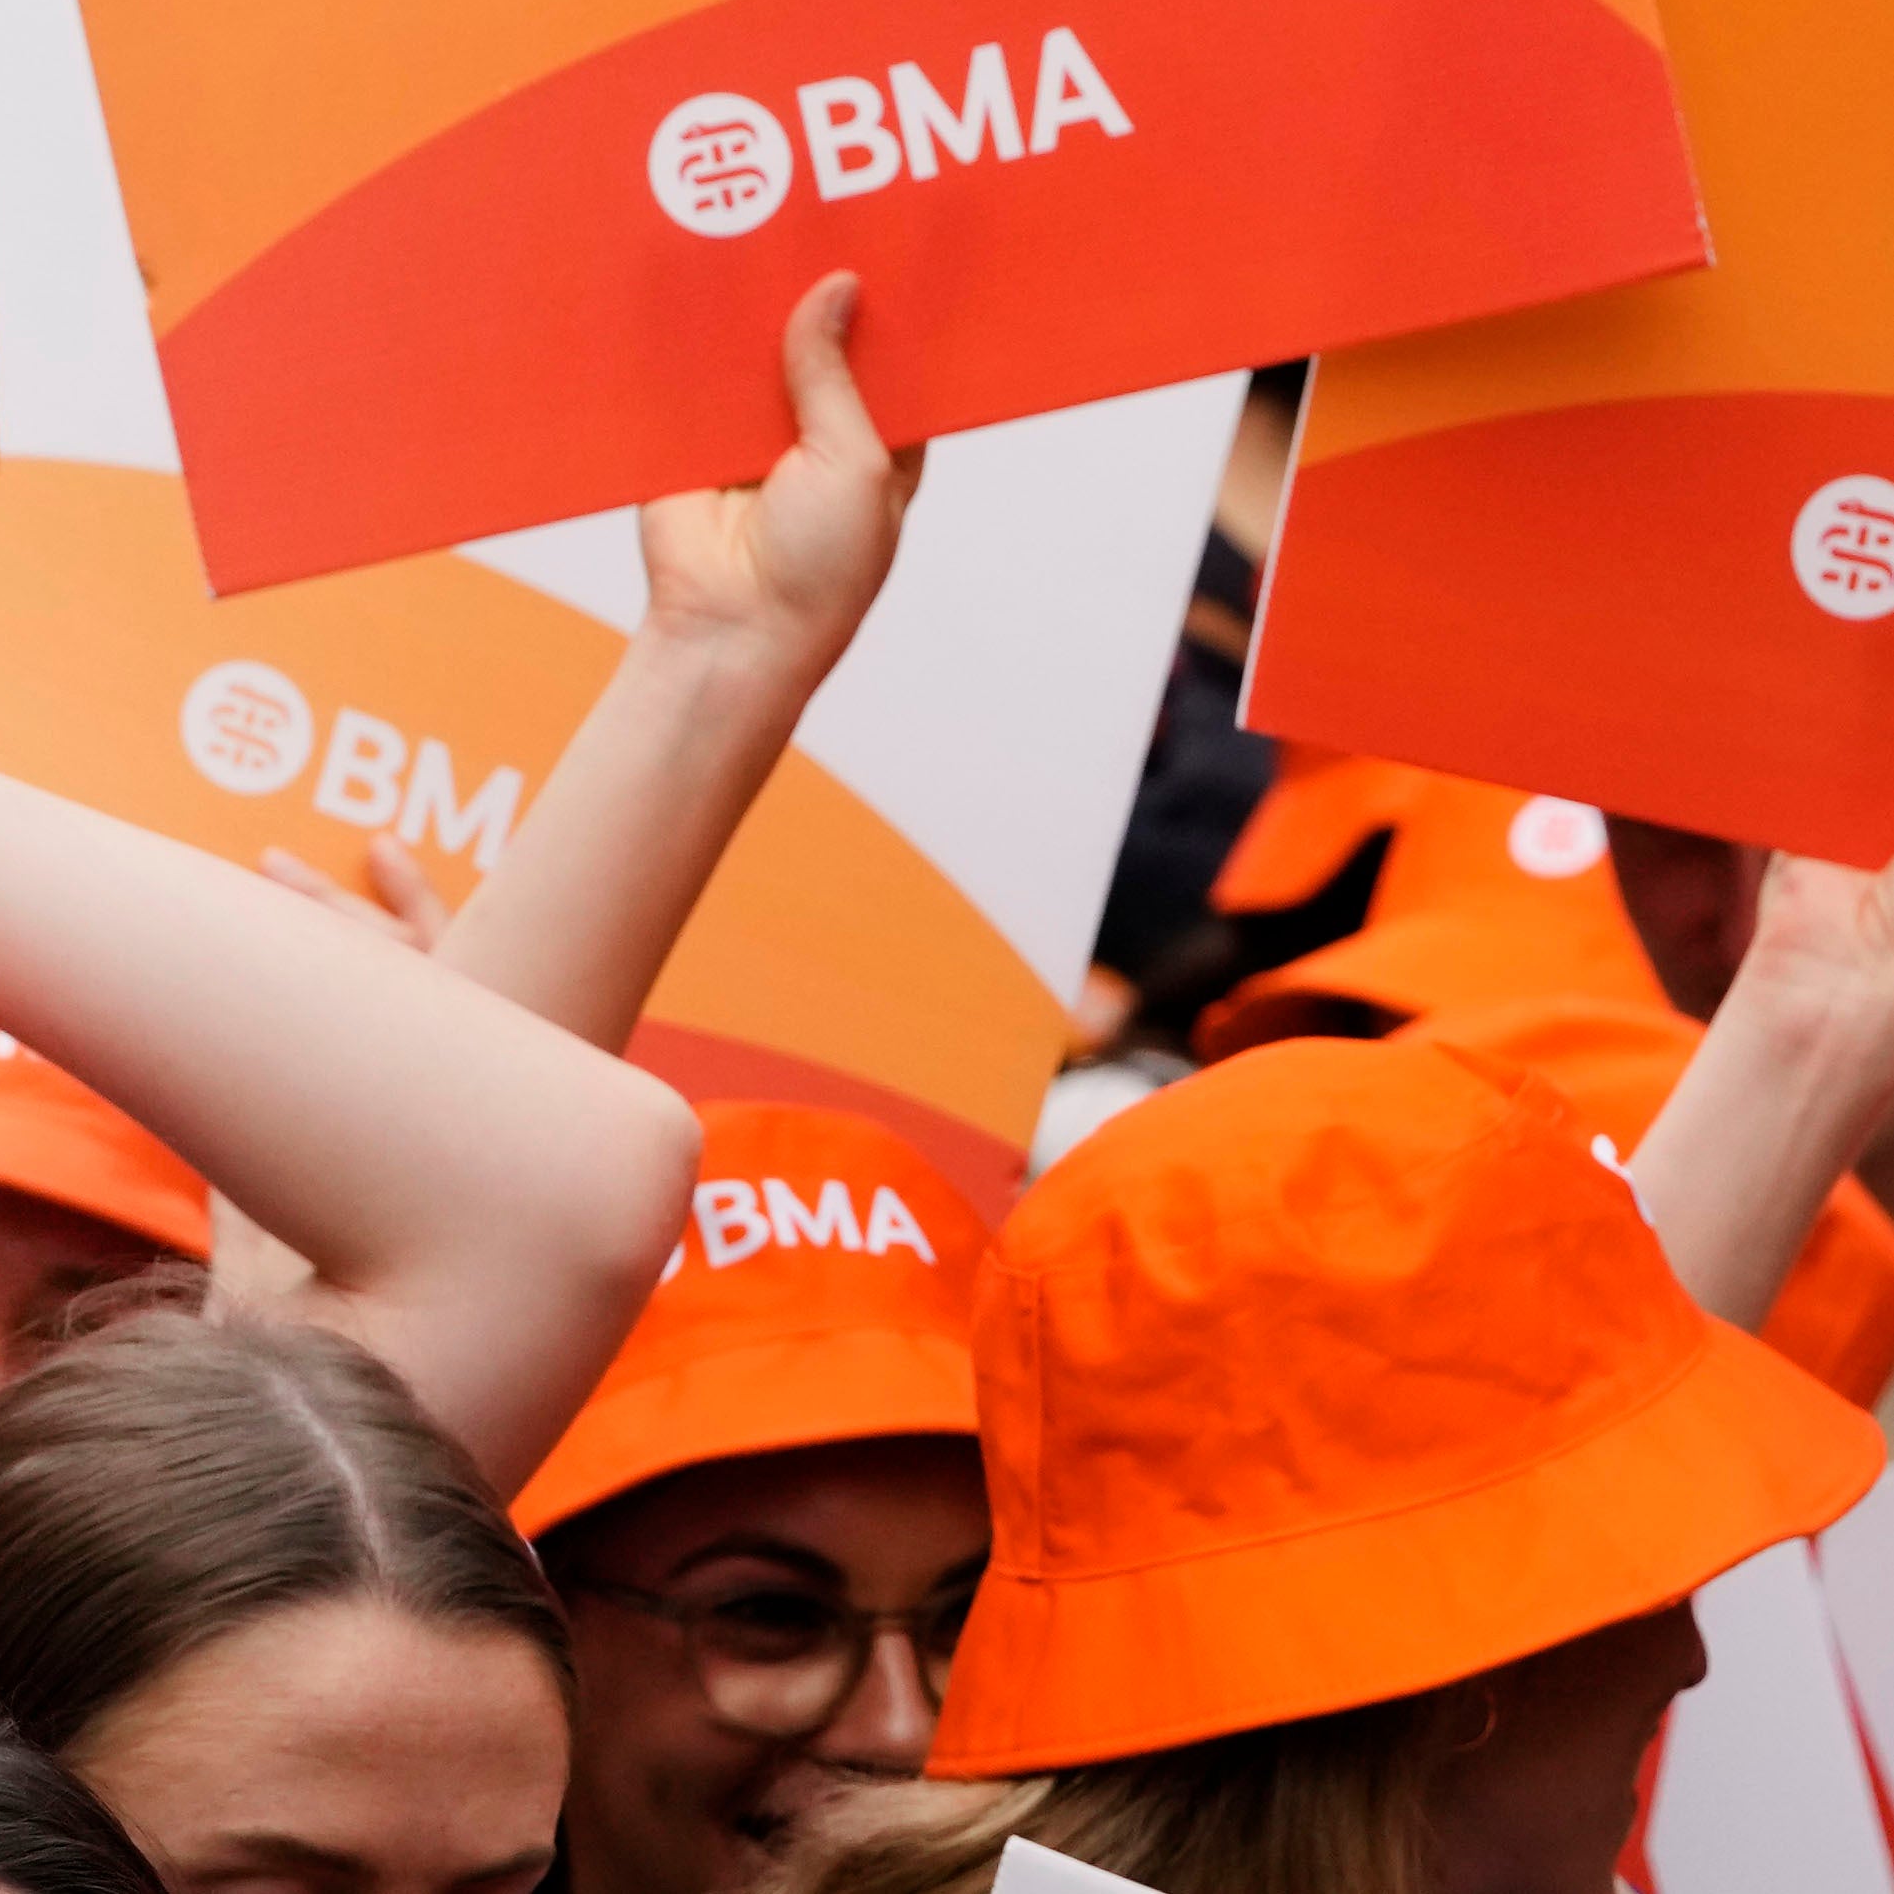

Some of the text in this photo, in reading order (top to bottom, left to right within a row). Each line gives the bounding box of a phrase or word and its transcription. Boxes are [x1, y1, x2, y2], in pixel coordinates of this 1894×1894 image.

[796, 25, 1135, 202] BMA
[314, 706, 525, 872] BM
[694, 1178, 938, 1270] BMA
